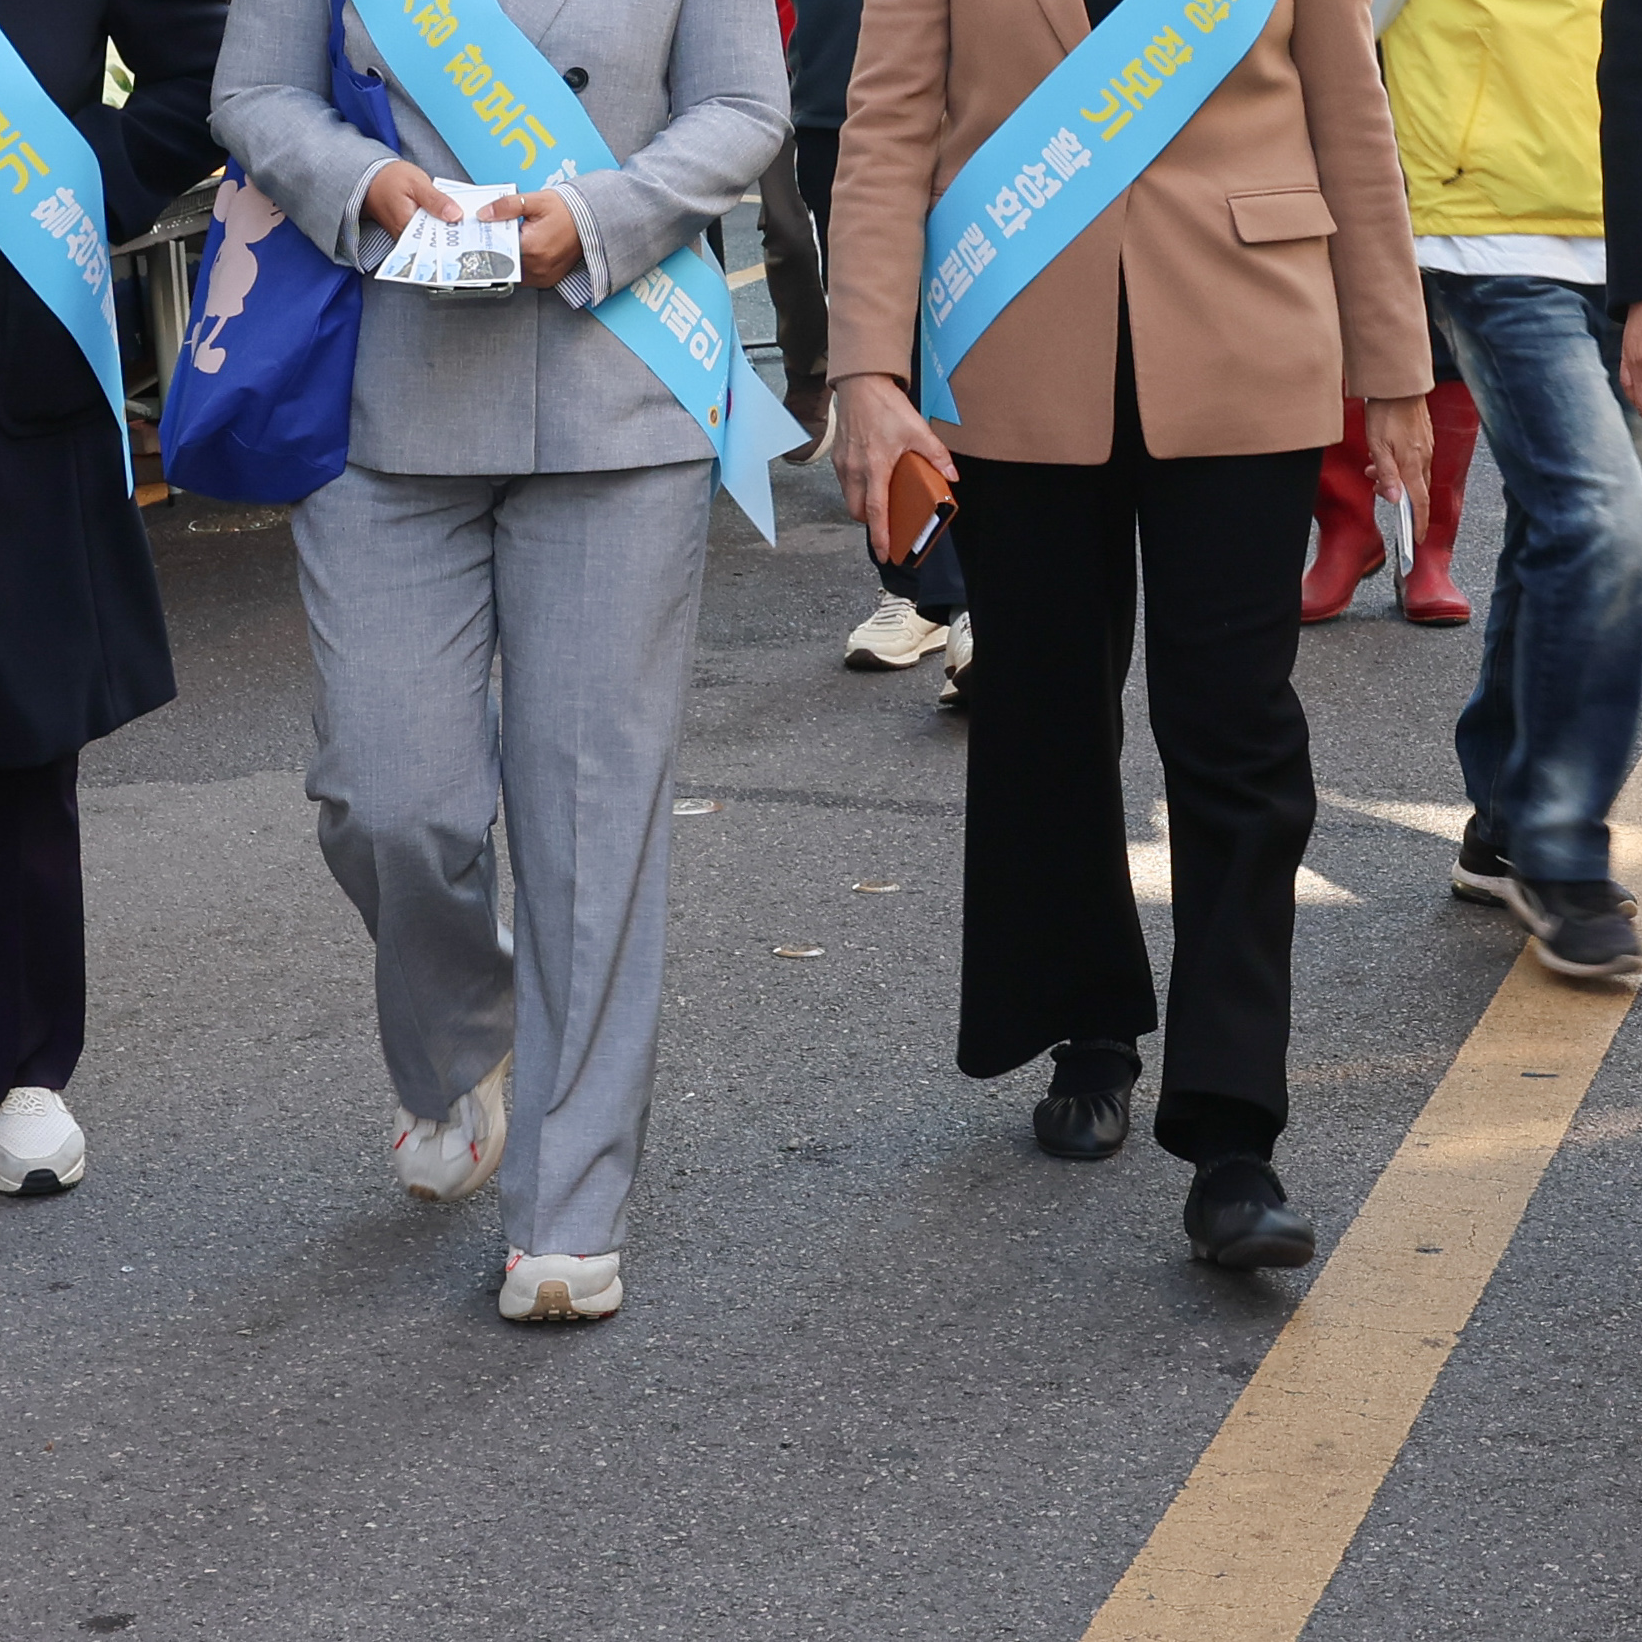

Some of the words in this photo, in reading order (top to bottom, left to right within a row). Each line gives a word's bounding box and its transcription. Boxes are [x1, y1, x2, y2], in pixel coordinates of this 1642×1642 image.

[442, 42, 557, 171] 장보기
[1079, 25, 1196, 143] 장보기
[985, 125, 1093, 242] 활성화
[927, 222, 998, 329] 캠페인
